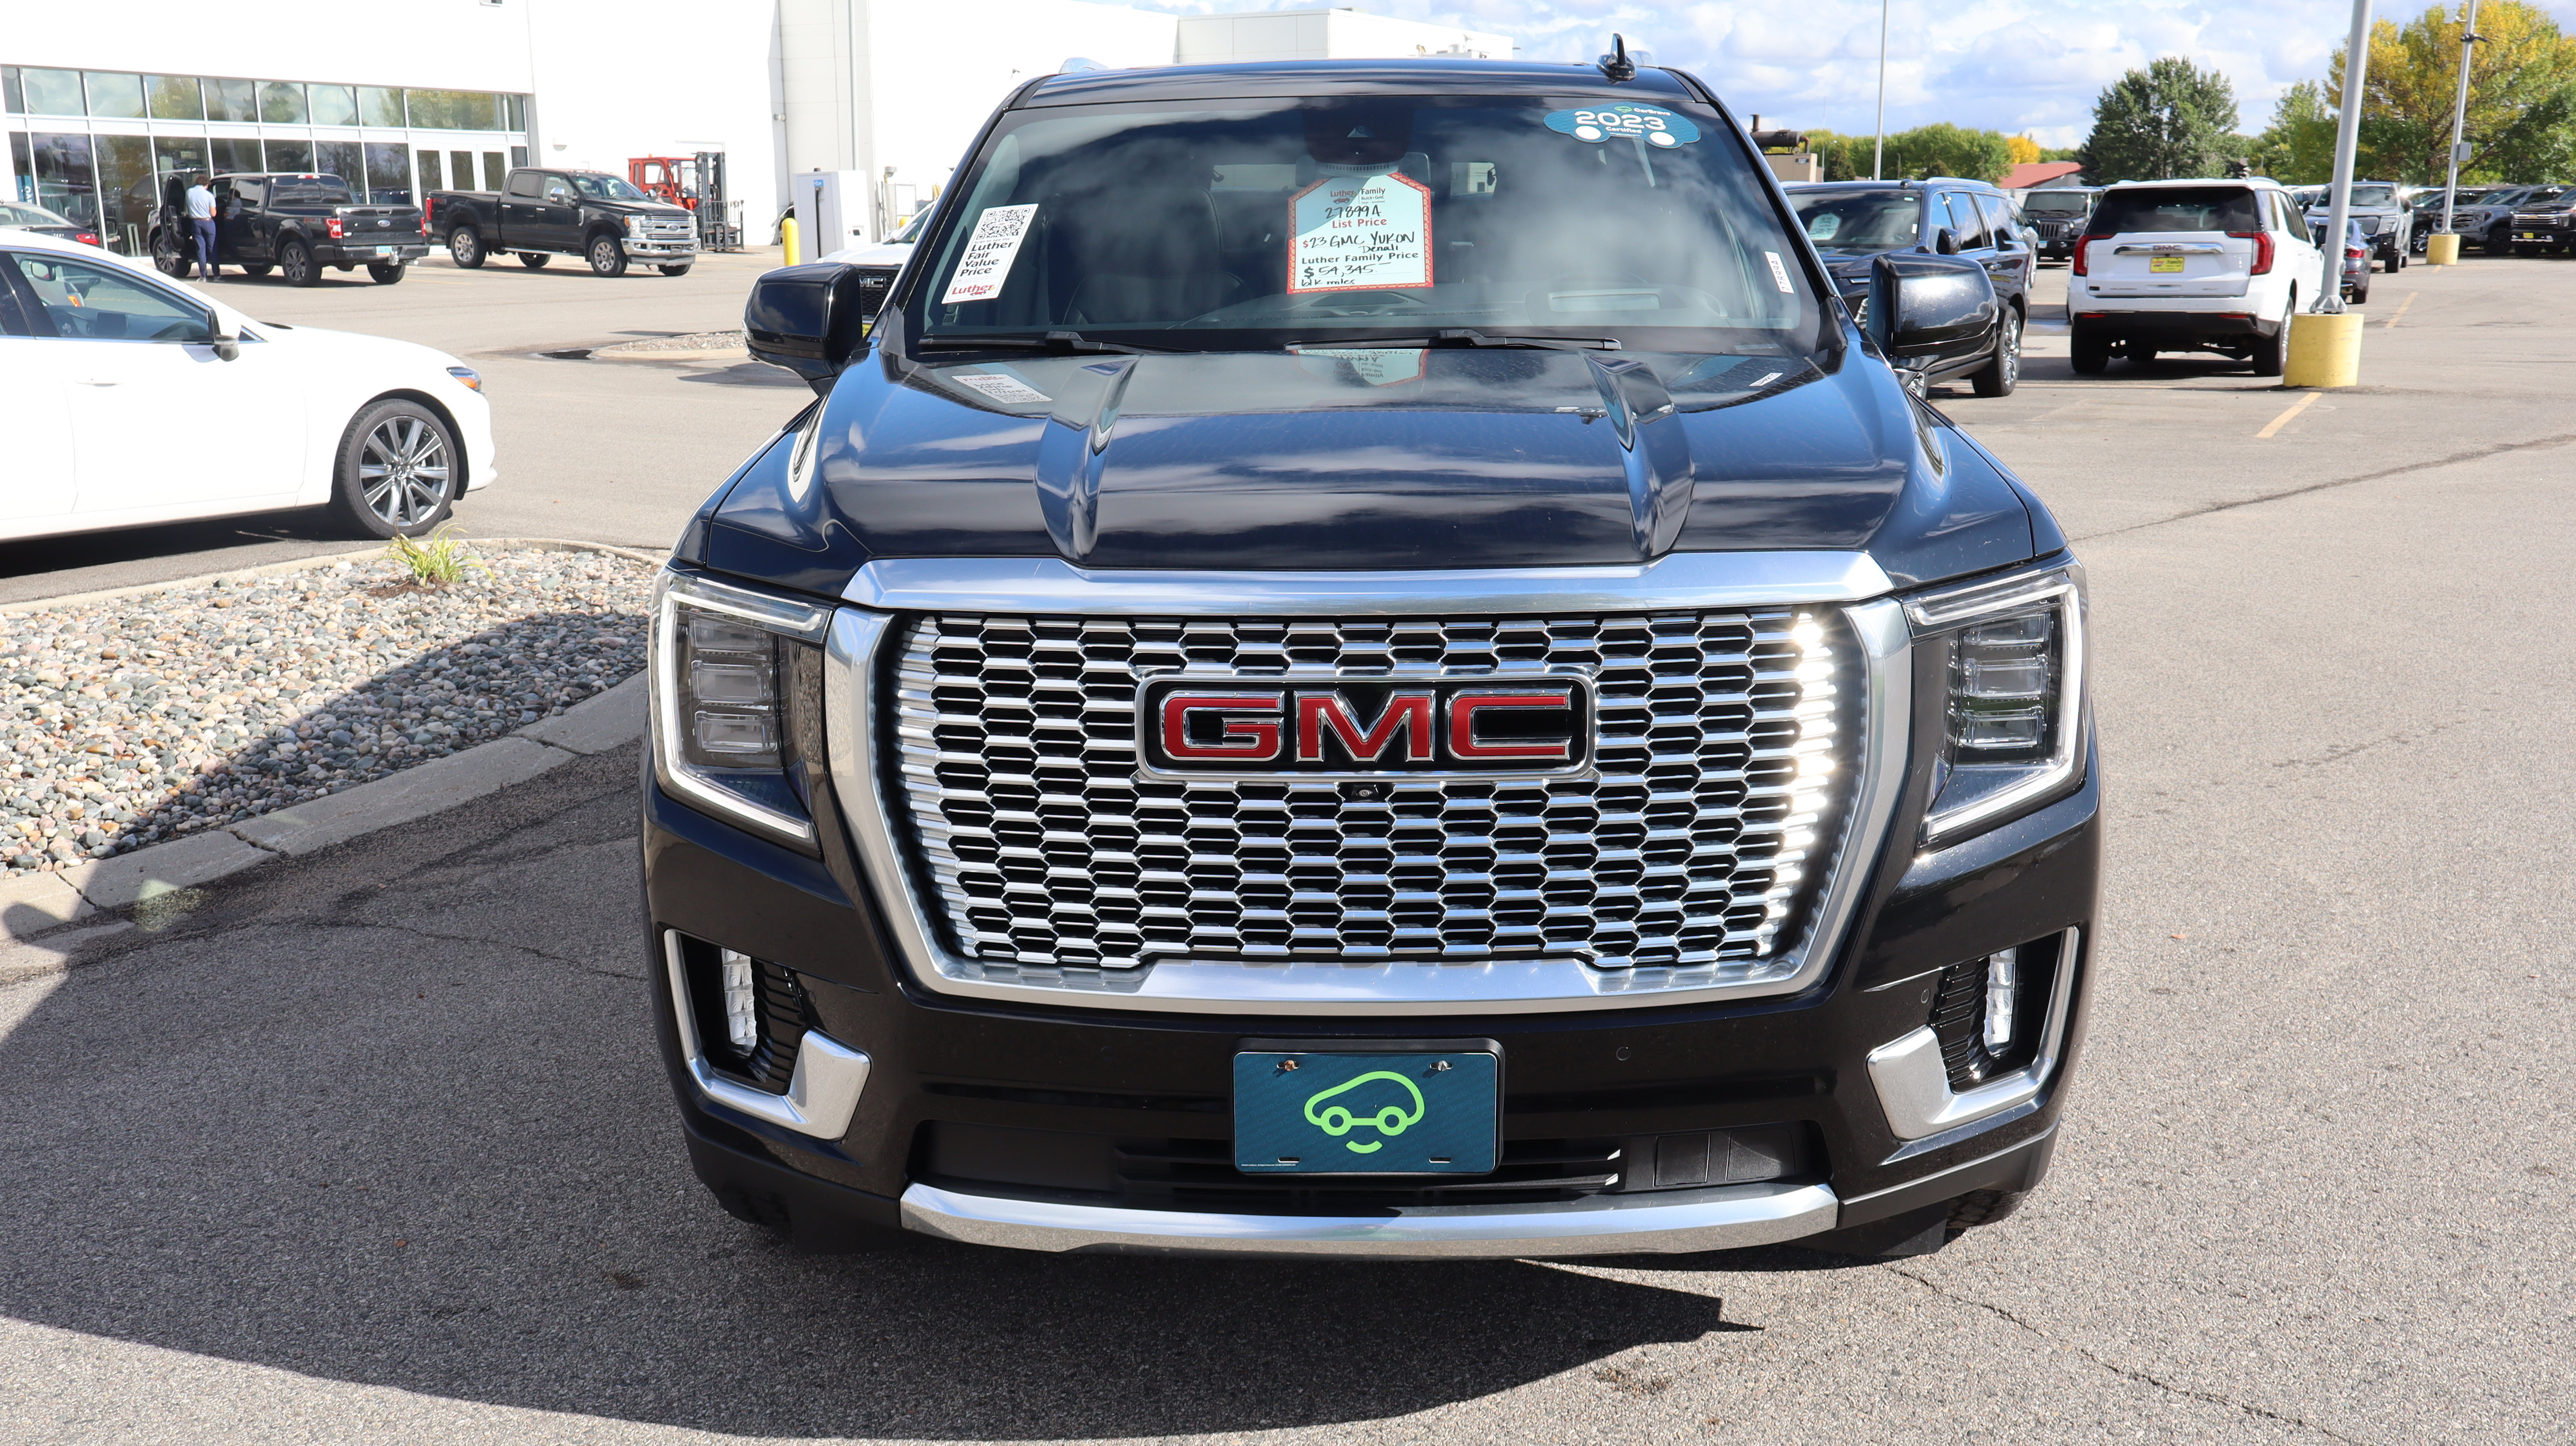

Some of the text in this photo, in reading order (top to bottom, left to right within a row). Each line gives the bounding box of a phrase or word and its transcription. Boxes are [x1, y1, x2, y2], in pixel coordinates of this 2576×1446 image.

[1634, 108, 1671, 116] CarBravo
[1574, 111, 1666, 130] 2023
[1332, 218, 1387, 229] List Price
[1330, 235, 1364, 248] GMC
[1370, 231, 1415, 246] YUKON
[971, 242, 1014, 251] Luther
[1358, 244, 1398, 253] Denali
[967, 250, 991, 260] Fair
[1302, 256, 1340, 264] Luther
[1345, 253, 1383, 262] Family
[966, 259, 1000, 267] Value
[960, 267, 992, 277] Price
[859, 278, 884, 288] MC
[952, 284, 995, 295] Luther
[1159, 688, 1572, 762] GMC
